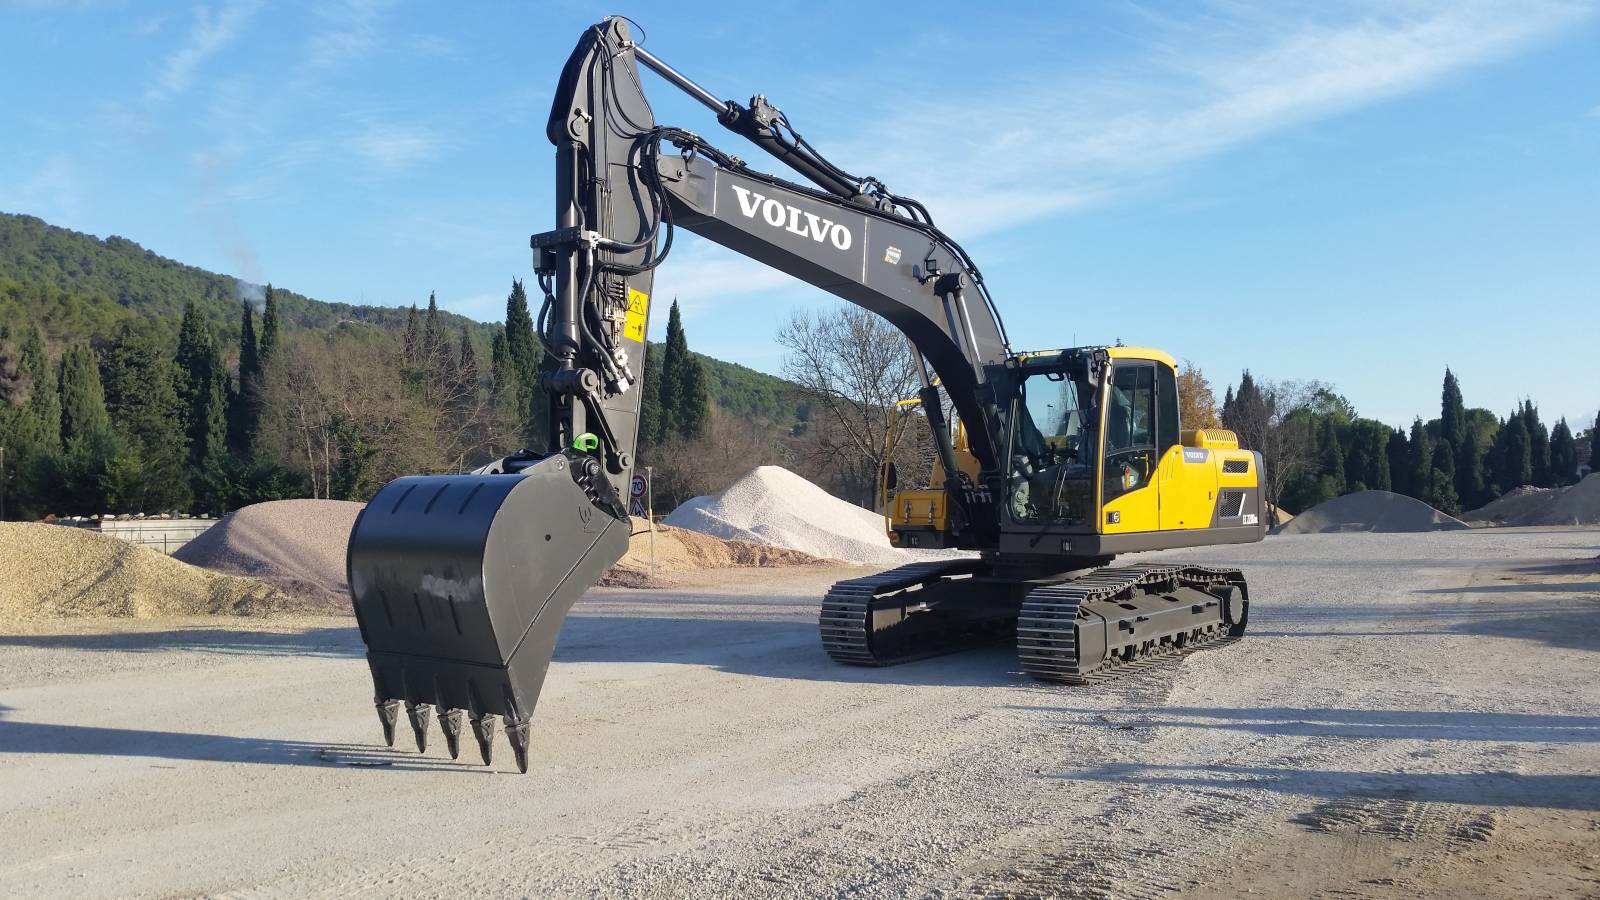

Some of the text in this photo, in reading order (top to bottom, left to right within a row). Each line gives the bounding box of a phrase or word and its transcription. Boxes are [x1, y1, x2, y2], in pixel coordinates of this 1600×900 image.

[732, 185, 851, 250] VOLVO
[1185, 451, 1204, 459] VOLVO
[632, 481, 642, 491] 70
